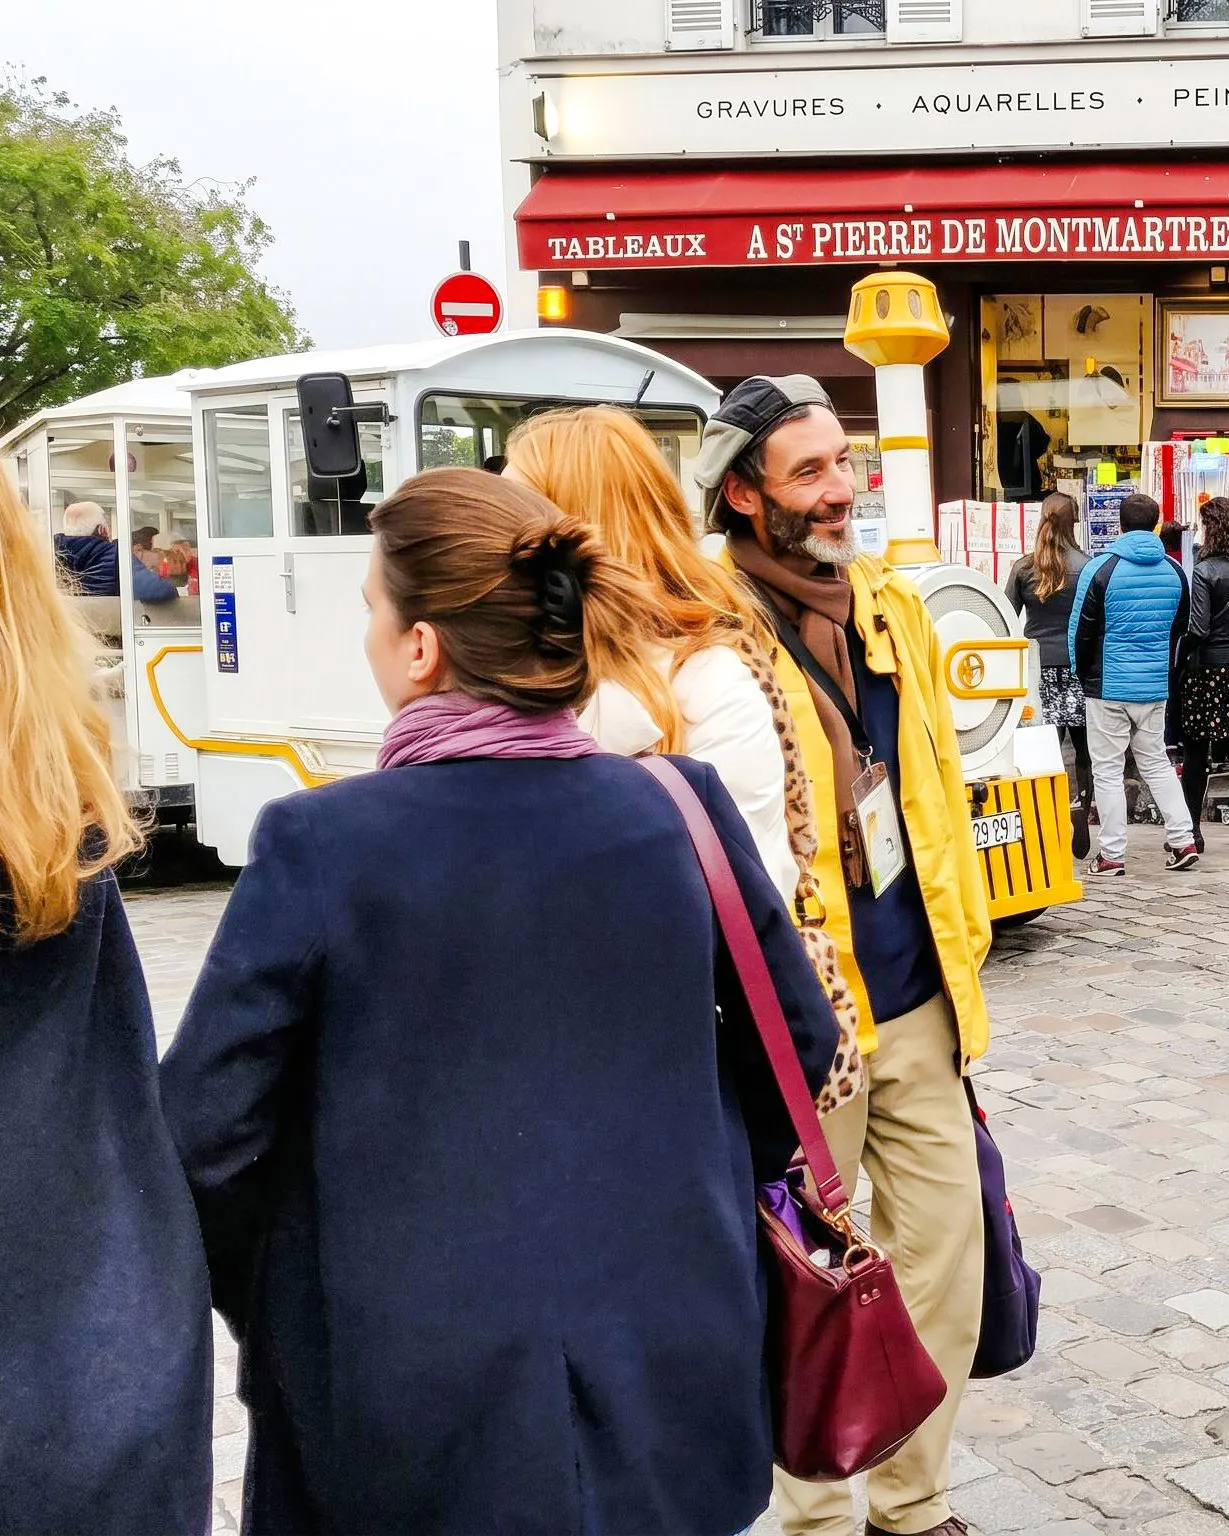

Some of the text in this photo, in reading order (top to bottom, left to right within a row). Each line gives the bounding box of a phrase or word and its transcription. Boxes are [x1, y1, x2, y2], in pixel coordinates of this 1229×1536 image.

[696, 97, 845, 119] GRAVURES
[911, 91, 1105, 115] AQUARELLES
[548, 233, 707, 260] TABLEAUX
[746, 224, 769, 259] A
[812, 219, 931, 257] PIERRE
[941, 219, 986, 254] DE
